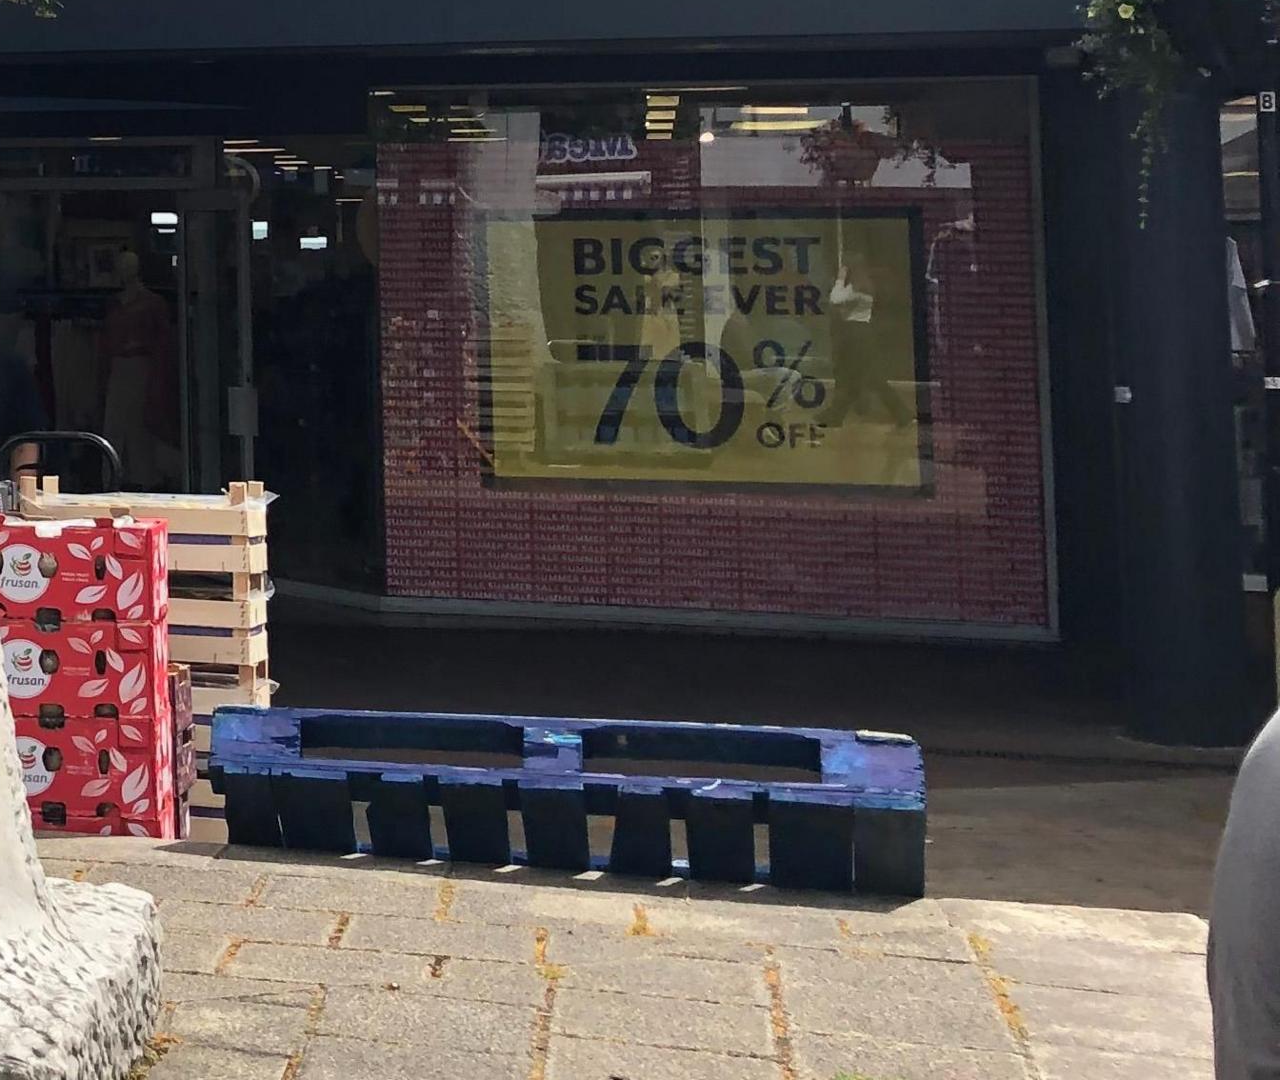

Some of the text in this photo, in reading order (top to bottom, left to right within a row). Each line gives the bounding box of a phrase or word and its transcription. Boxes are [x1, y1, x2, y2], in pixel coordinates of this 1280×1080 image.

[573, 236, 821, 276] BIGGEST
[575, 284, 825, 317] SALE EVER
[755, 421, 827, 449] OFF
[0, 575, 40, 590] frusan
[7, 671, 45, 686] frusan
